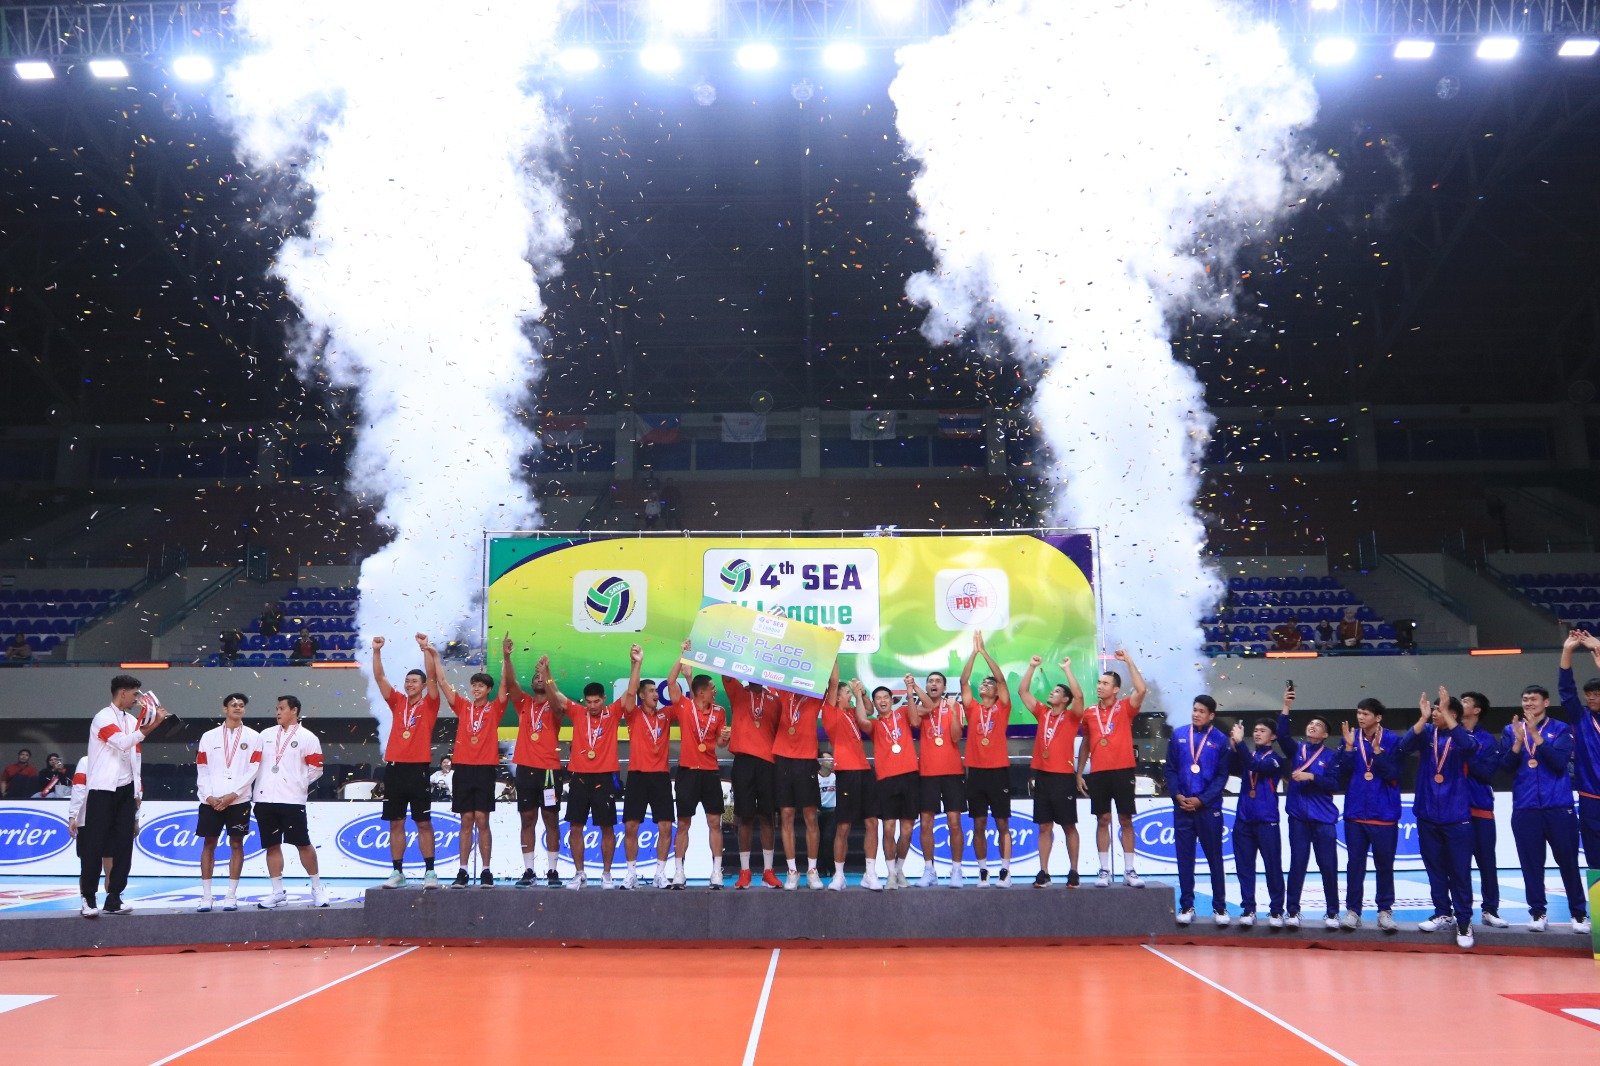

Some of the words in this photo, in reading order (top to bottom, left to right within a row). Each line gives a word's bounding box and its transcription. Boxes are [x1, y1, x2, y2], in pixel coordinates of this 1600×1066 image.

[760, 561, 794, 590] 4th
[802, 564, 862, 590] SEA
[608, 582, 626, 596] SAVA
[757, 601, 853, 626] ague
[956, 596, 988, 610] PBVSI
[708, 638, 744, 655] USD
[753, 649, 812, 672] 16.000
[725, 630, 749, 644] 1st
[755, 638, 804, 657] PLACE
